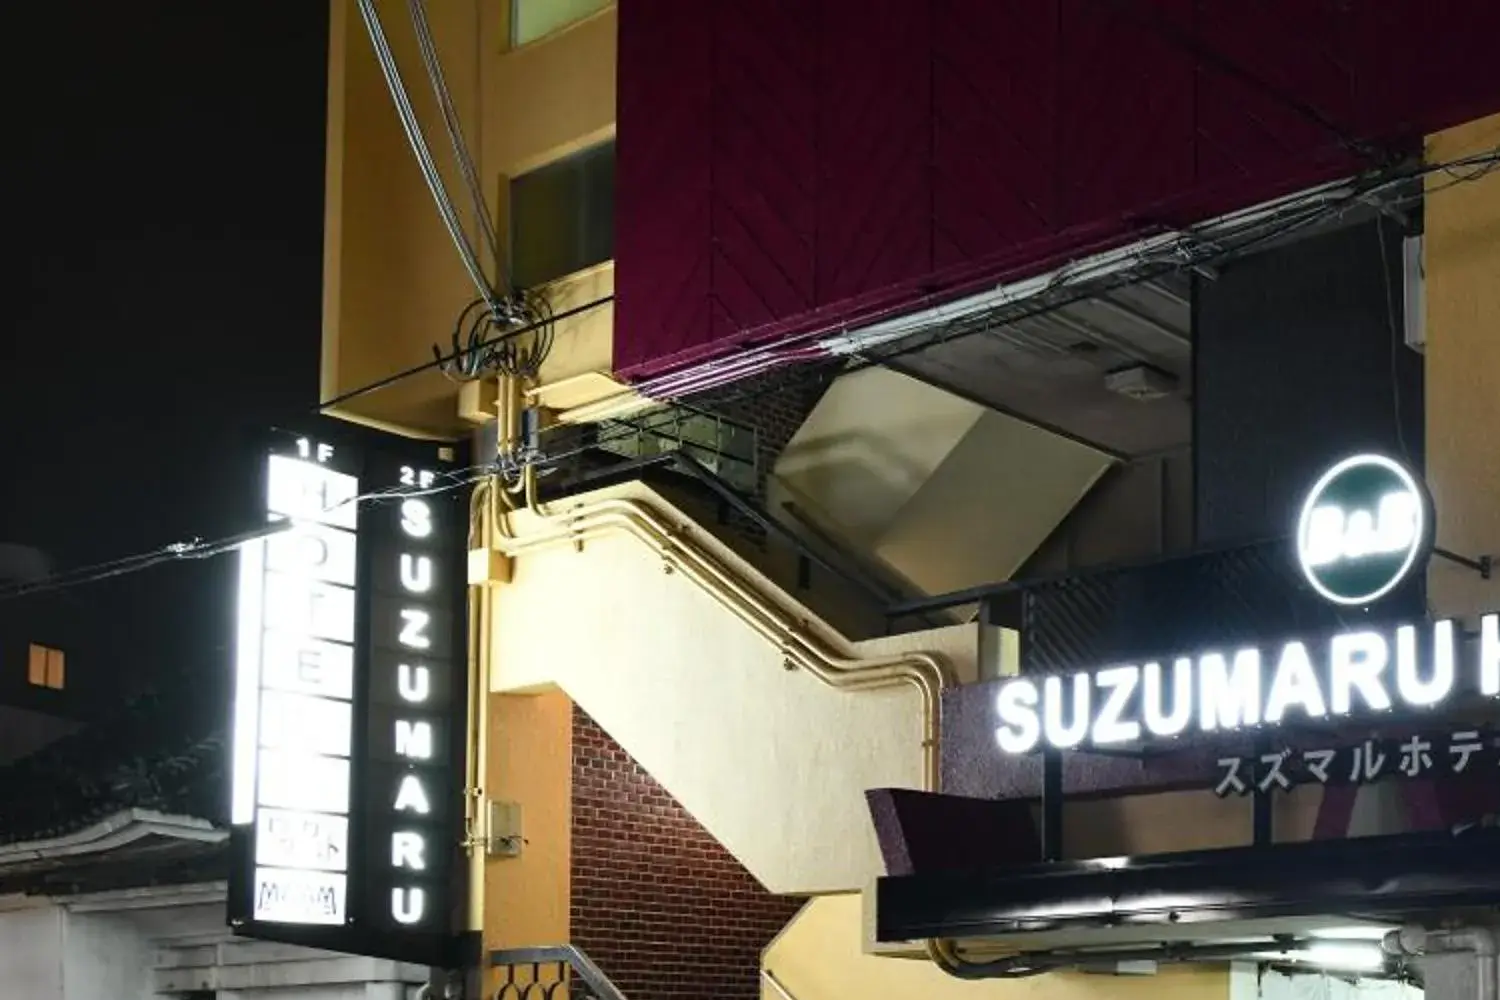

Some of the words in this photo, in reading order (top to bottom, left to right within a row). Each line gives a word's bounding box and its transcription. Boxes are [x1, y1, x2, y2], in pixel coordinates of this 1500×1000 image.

[297, 437, 334, 463] 1F
[400, 466, 435, 489] 2F
[391, 499, 432, 925] SUZUMARU
[995, 616, 1454, 754] SUZUMARU
